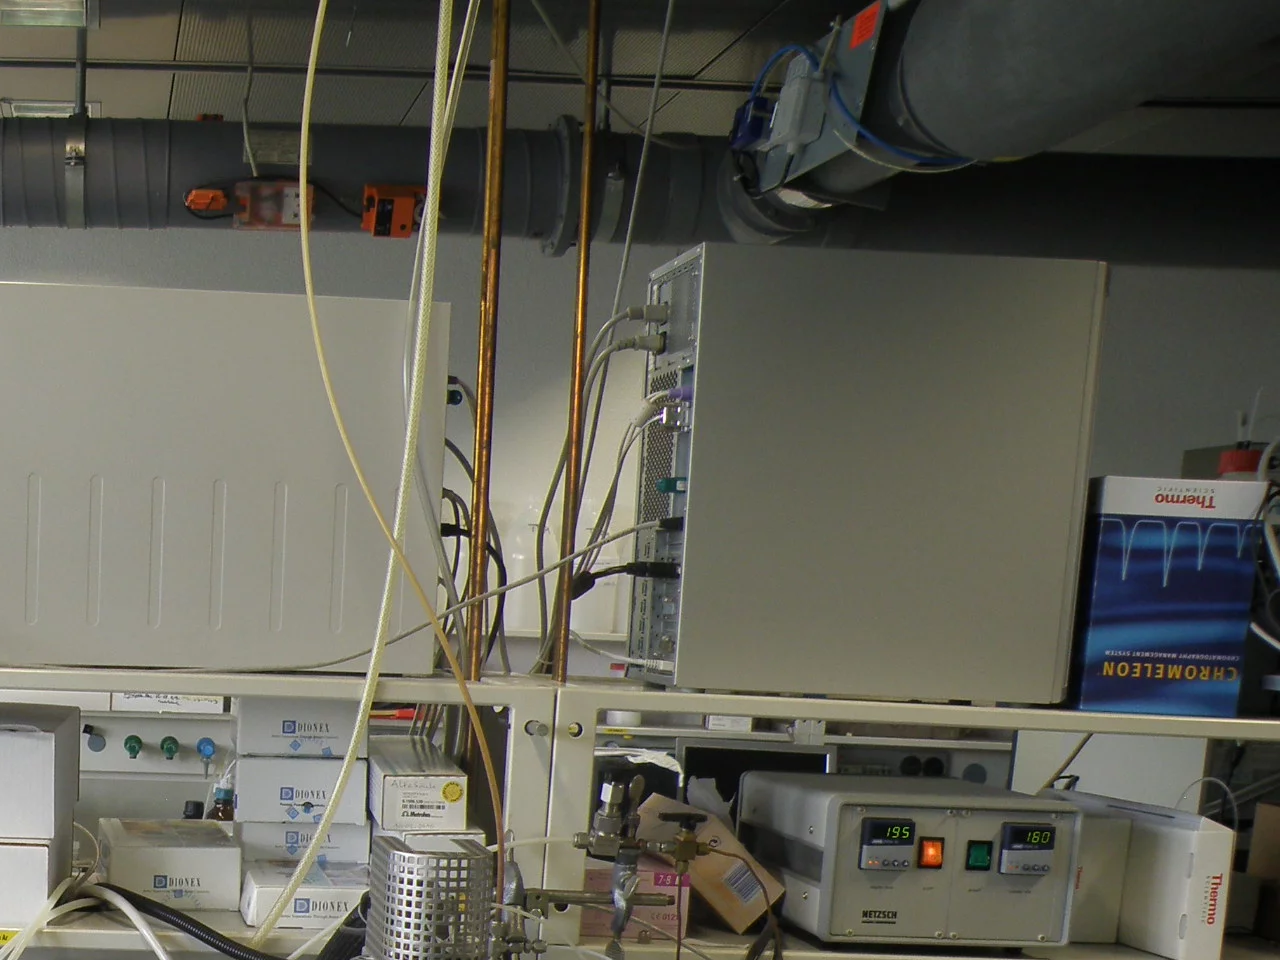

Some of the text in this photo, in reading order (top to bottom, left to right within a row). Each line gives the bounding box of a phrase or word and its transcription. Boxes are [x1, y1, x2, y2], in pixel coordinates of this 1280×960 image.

[1154, 493, 1216, 509] Thermo
[1101, 661, 1239, 681] CHROMELEON
[297, 722, 330, 733] DIONEX
[295, 789, 326, 799] DIONEX
[886, 826, 911, 839] 195
[1026, 831, 1051, 844] 180
[169, 877, 201, 887] DIONEX
[1207, 872, 1223, 925] Thermo
[311, 901, 348, 911] DIONEX
[862, 910, 897, 919] NETZSCH
